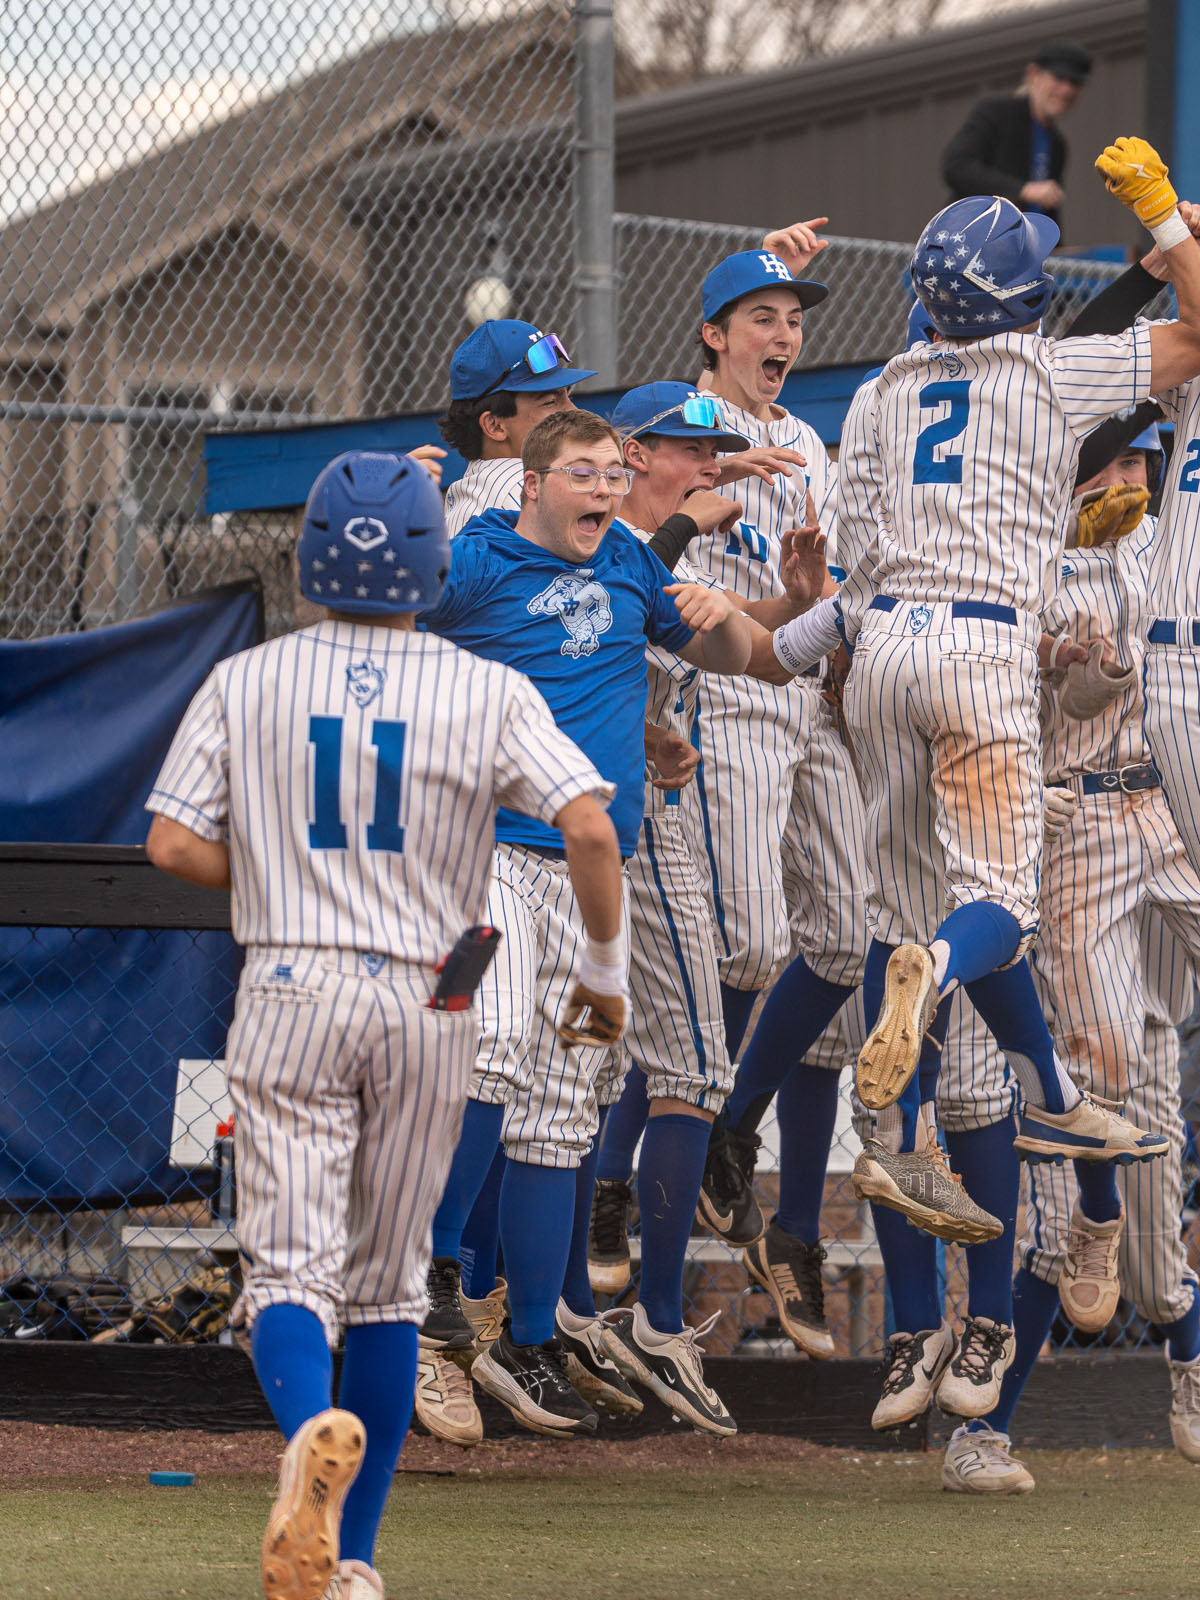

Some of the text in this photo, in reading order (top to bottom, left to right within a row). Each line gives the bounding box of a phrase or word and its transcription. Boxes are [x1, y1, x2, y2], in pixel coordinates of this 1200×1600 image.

[757, 253, 793, 281] HR
[912, 380, 973, 485] 2
[780, 641, 801, 668] BRUCE
[307, 716, 408, 854] 11
[770, 1263, 802, 1304] NIKE
